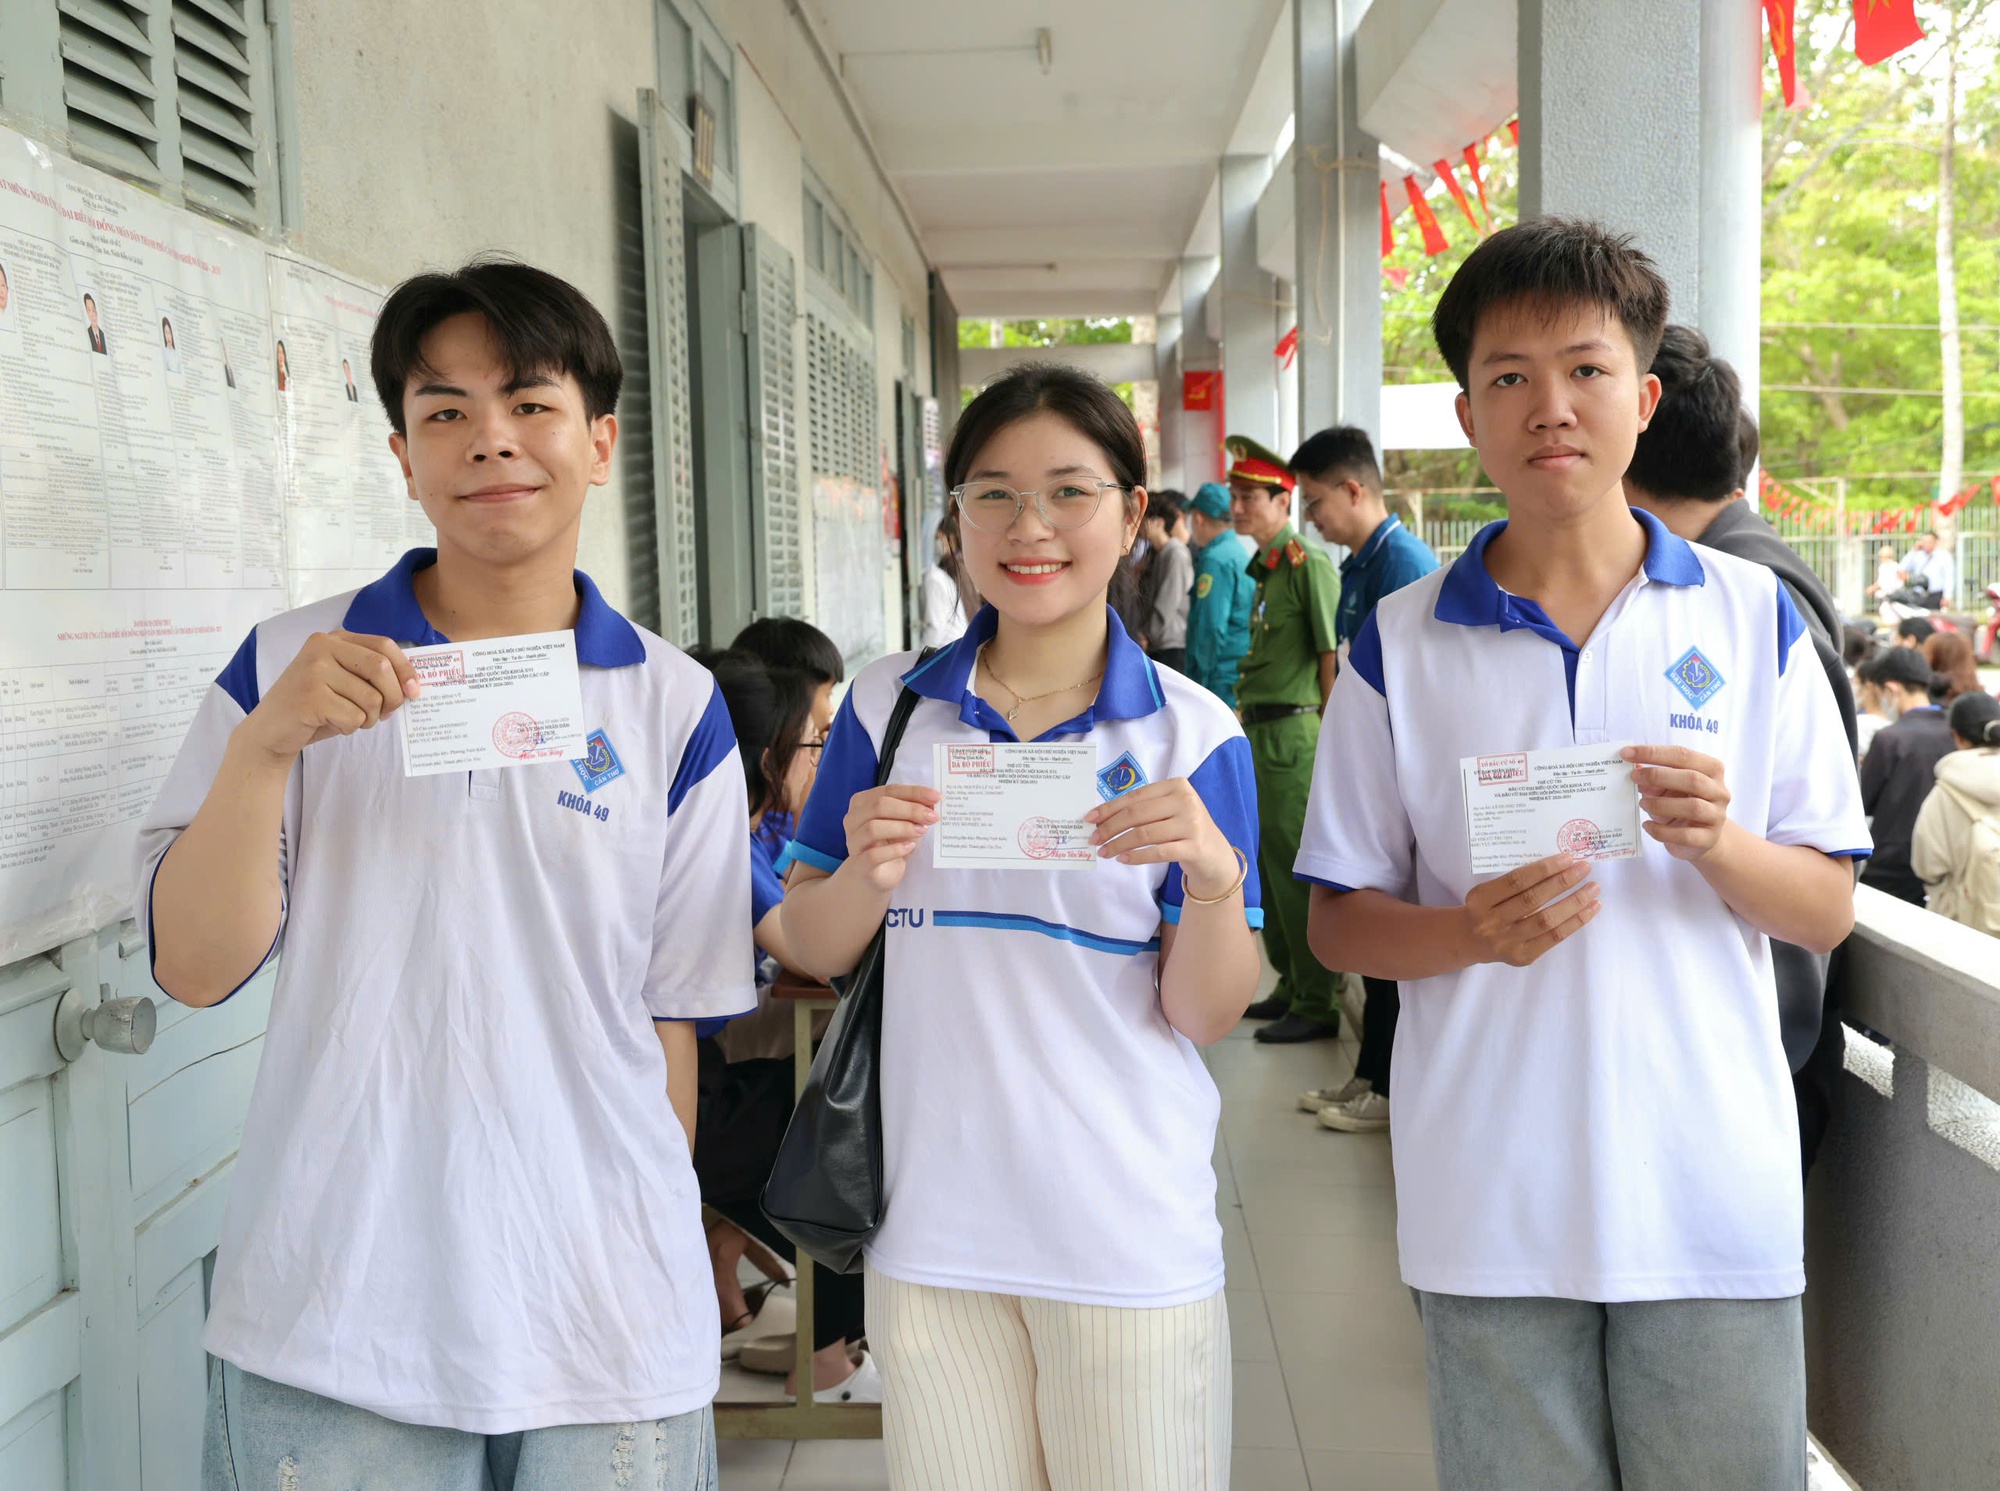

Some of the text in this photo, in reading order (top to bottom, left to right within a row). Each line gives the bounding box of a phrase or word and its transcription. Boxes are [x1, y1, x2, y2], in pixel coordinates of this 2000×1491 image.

[1670, 713, 1719, 734] KHÓA 49
[577, 764, 589, 781] HỌC
[594, 776, 608, 786] CẦN
[557, 790, 610, 822] KHÓA 49
[886, 908, 924, 928] CTU
